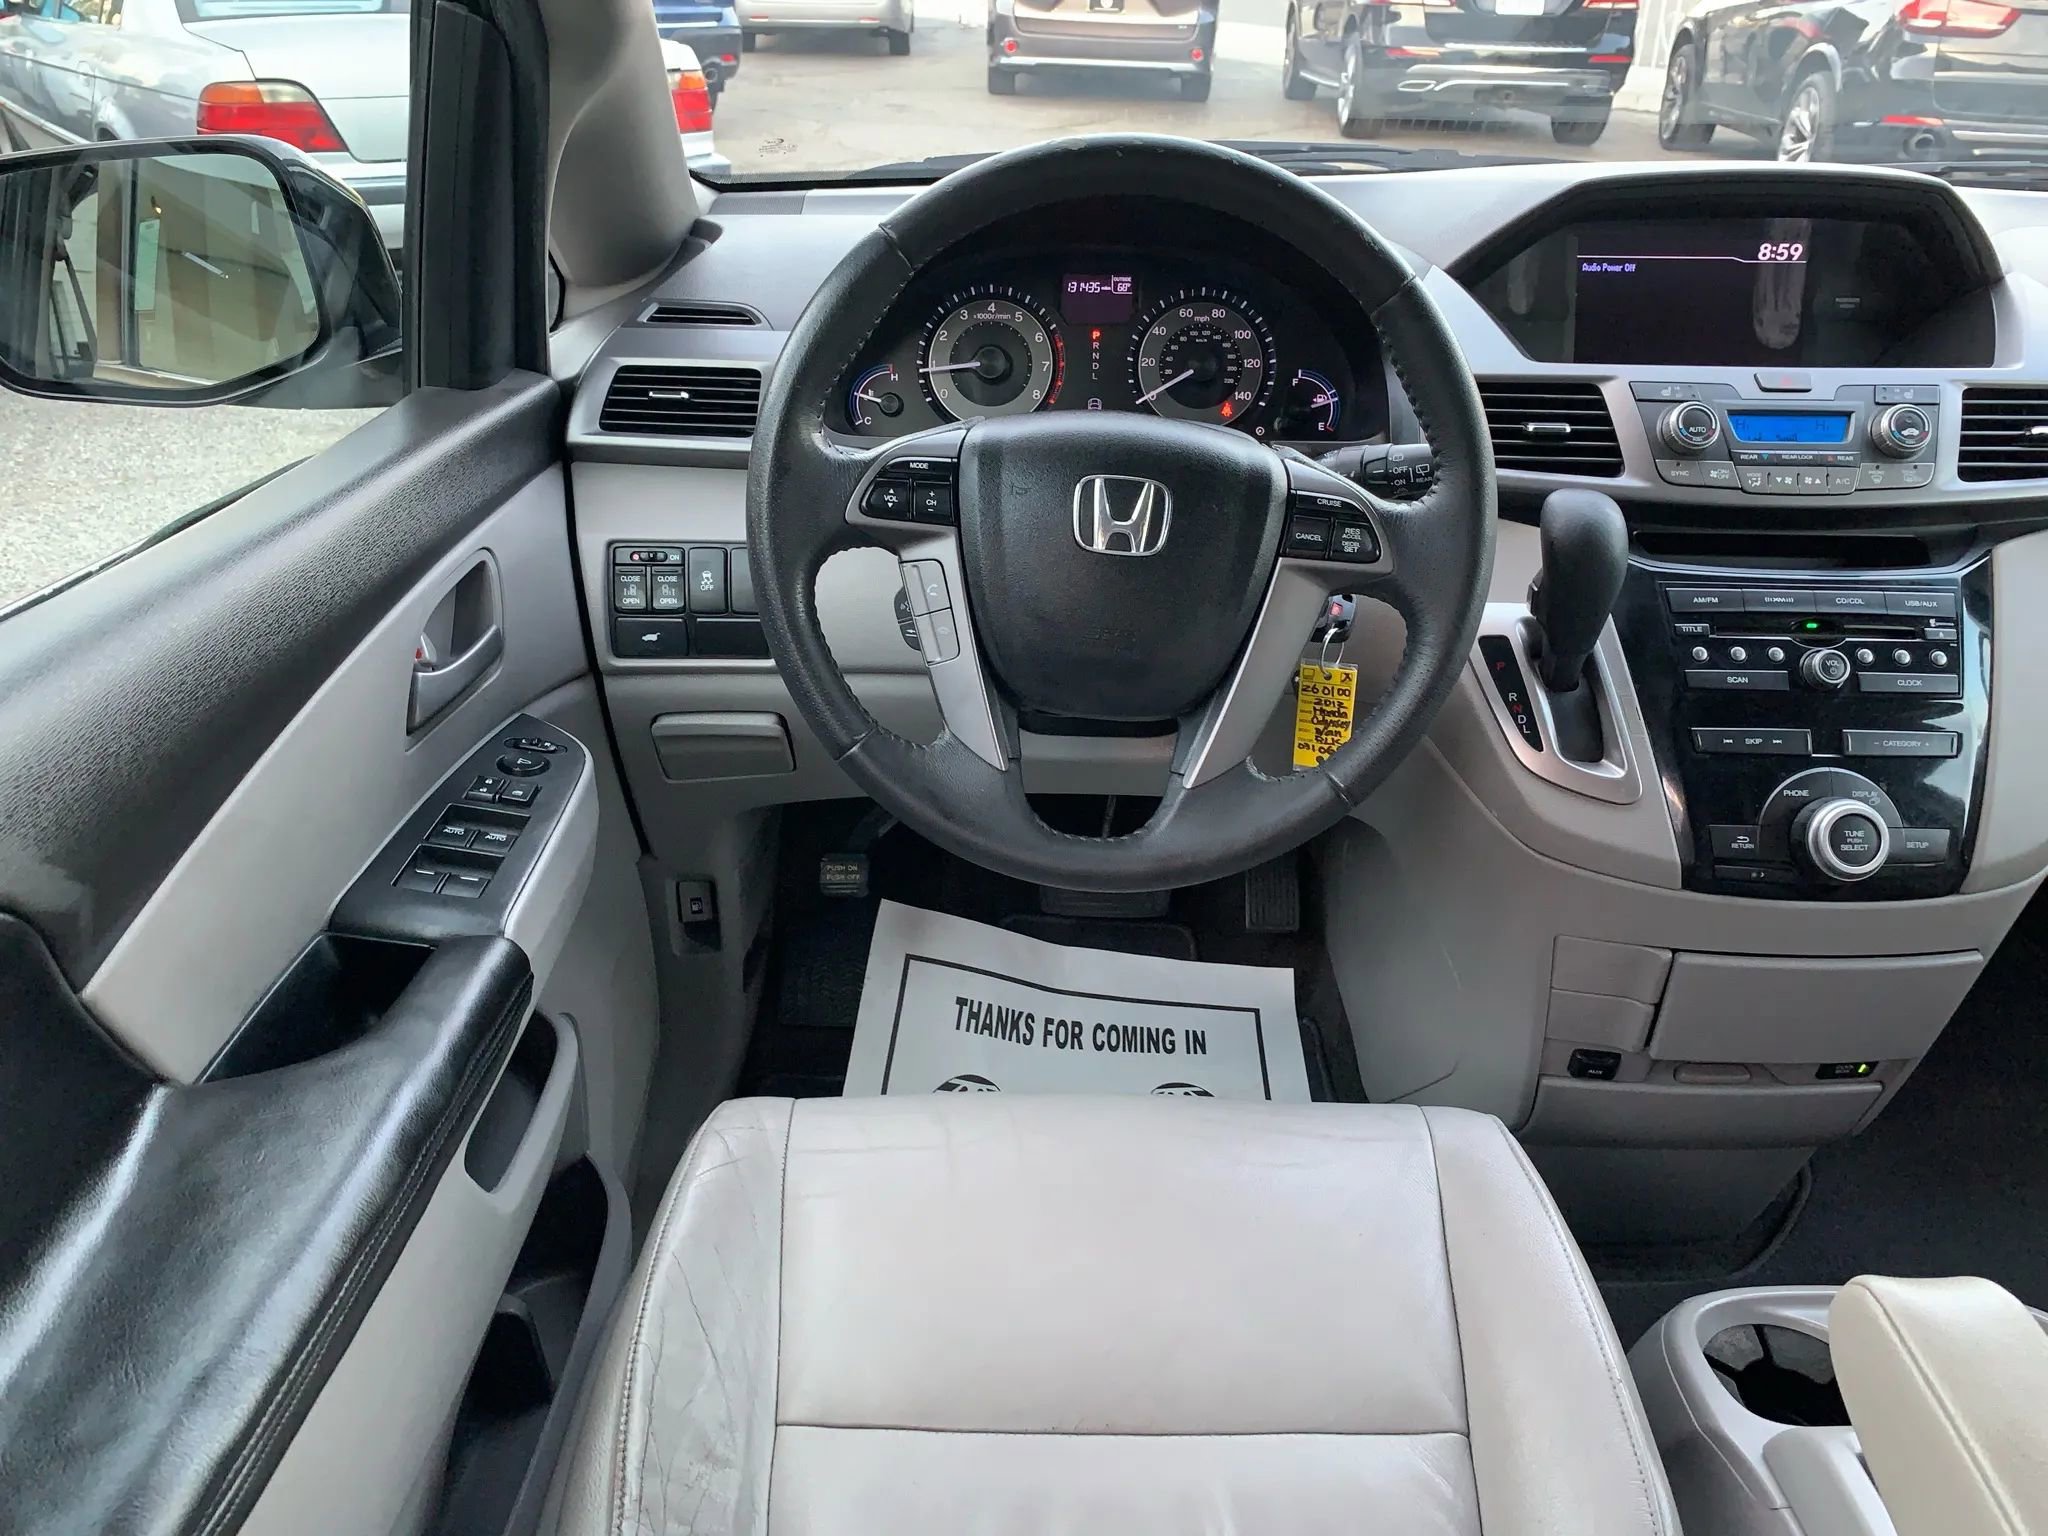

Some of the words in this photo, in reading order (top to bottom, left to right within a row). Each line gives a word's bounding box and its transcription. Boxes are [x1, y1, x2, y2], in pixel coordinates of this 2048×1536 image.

[1758, 243, 1804, 261] 8:59
[1582, 262, 1601, 272] Audio
[1602, 262, 1623, 272] Power
[987, 302, 996, 313] 4
[959, 309, 969, 321] 3
[1014, 311, 1024, 323] 5
[1179, 308, 1193, 319] 60
[1211, 308, 1226, 319] 80
[1194, 314, 1211, 323] mph
[1092, 331, 1101, 340] P
[1152, 326, 1167, 336] 40
[1234, 329, 1252, 341] 100
[939, 330, 948, 342] 2
[1035, 332, 1044, 344] 6
[1092, 342, 1100, 350] R
[1092, 352, 1100, 360] N
[1041, 361, 1050, 373] 7
[1092, 362, 1100, 370] D
[1141, 357, 1156, 368] 20
[1243, 358, 1261, 369] 120
[890, 373, 899, 382] H
[1292, 378, 1299, 387] F
[939, 388, 948, 400] 0
[1032, 388, 1041, 400] 8
[1234, 391, 1252, 401] 140
[864, 415, 872, 425] C
[1318, 422, 1325, 431] E
[909, 462, 929, 470] MODE
[1393, 466, 1408, 474] OFF
[884, 494, 899, 503] VOL
[926, 499, 937, 507] CH
[1317, 498, 1342, 508] CRUISE
[1344, 527, 1361, 535] RES
[1295, 532, 1323, 542] CANCEL
[1904, 600, 1938, 608] USB/AUX
[1495, 661, 1505, 670] P
[1726, 676, 1749, 684] SCAN
[1508, 692, 1518, 702] R
[1512, 704, 1522, 713] N
[1517, 714, 1527, 724] D
[1523, 725, 1531, 734] L
[1745, 737, 1763, 745] SKIP
[1882, 739, 1922, 748] CATEGORY
[1783, 789, 1810, 797] PHONE
[443, 828, 465, 836] AUTO
[484, 834, 507, 842] AUTO
[1906, 841, 1929, 849] SETUP
[955, 996, 1036, 1046] THANKS
[1042, 1016, 1084, 1050] FOR
[1092, 1022, 1176, 1055] COMING
[1185, 1029, 1208, 1055] IN
